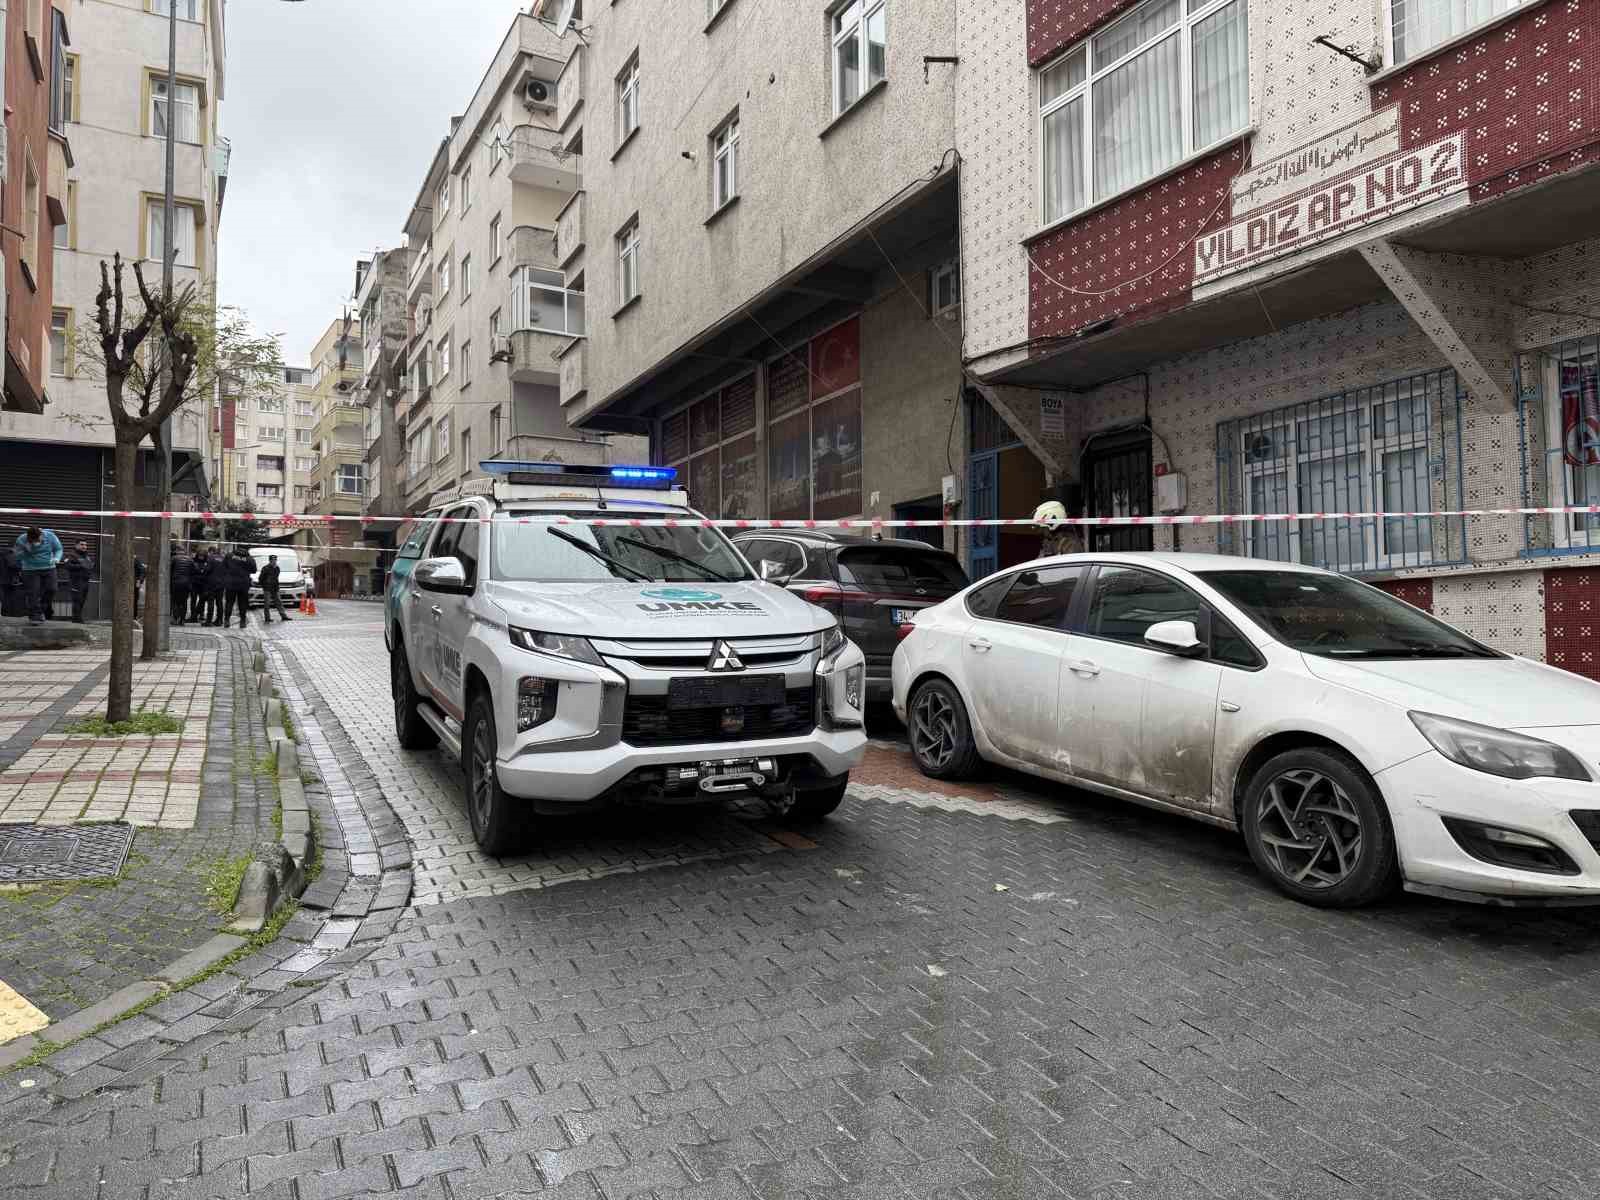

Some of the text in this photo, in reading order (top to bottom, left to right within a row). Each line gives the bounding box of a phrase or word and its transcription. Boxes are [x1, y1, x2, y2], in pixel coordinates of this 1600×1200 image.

[1197, 203, 1299, 269] YILDIZ
[1366, 154, 1420, 208] NO
[1431, 141, 1459, 187] 2
[636, 602, 762, 612] UMKE
